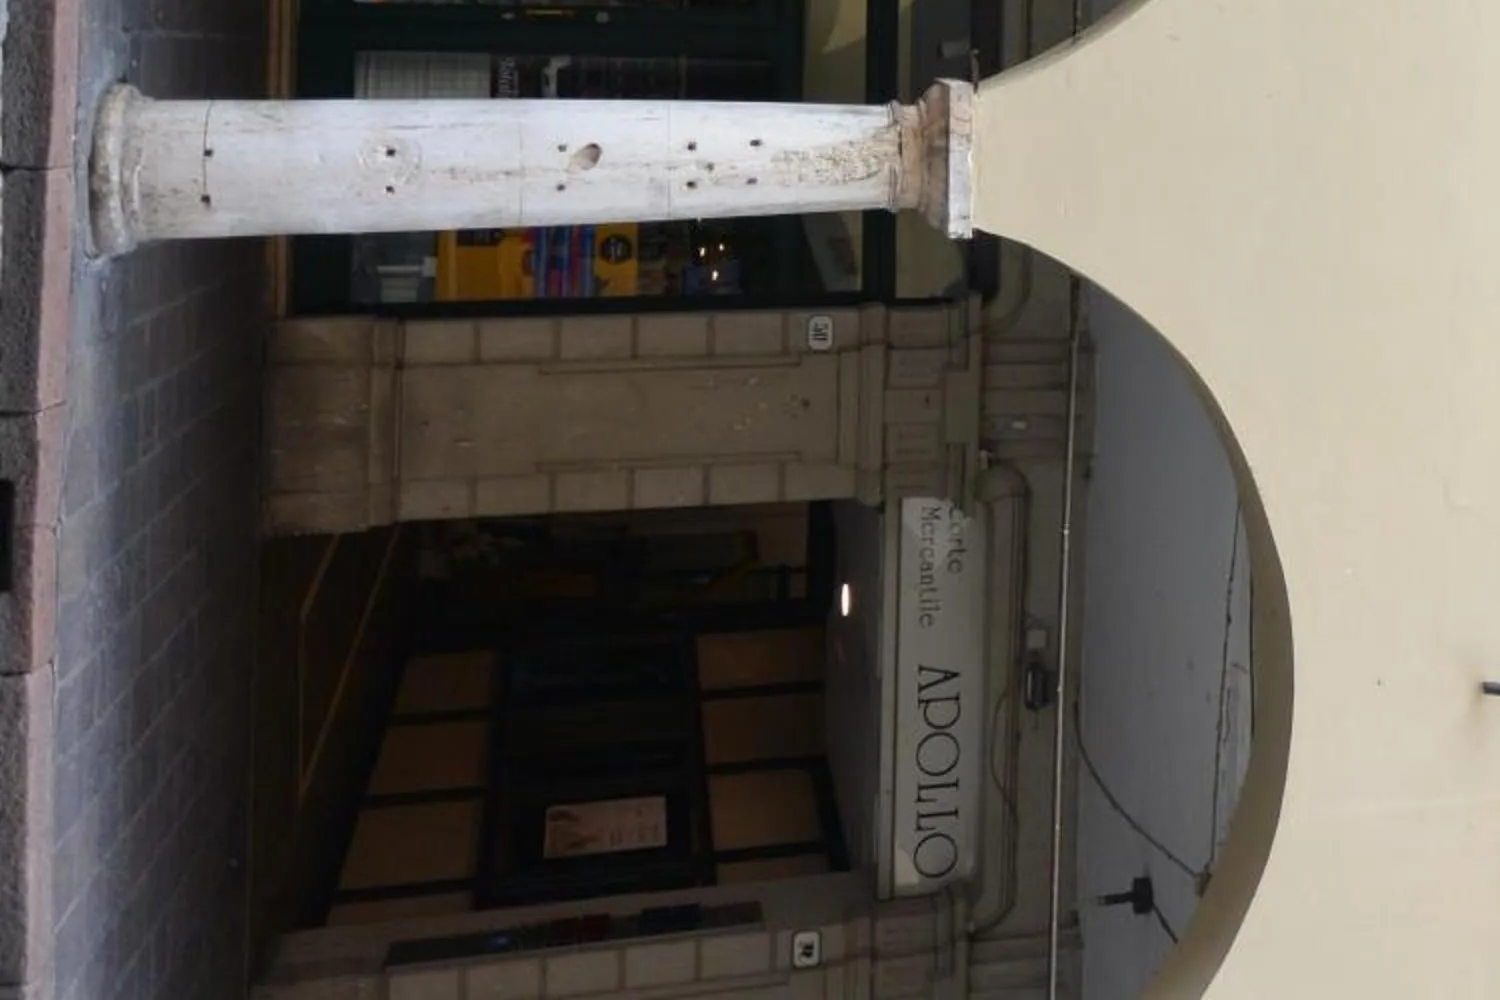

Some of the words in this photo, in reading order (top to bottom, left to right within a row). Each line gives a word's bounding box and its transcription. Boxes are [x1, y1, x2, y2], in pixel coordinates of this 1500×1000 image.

[918, 505, 942, 629] Mercantile
[947, 504, 967, 573] Corte
[913, 664, 962, 879] APOLLO
